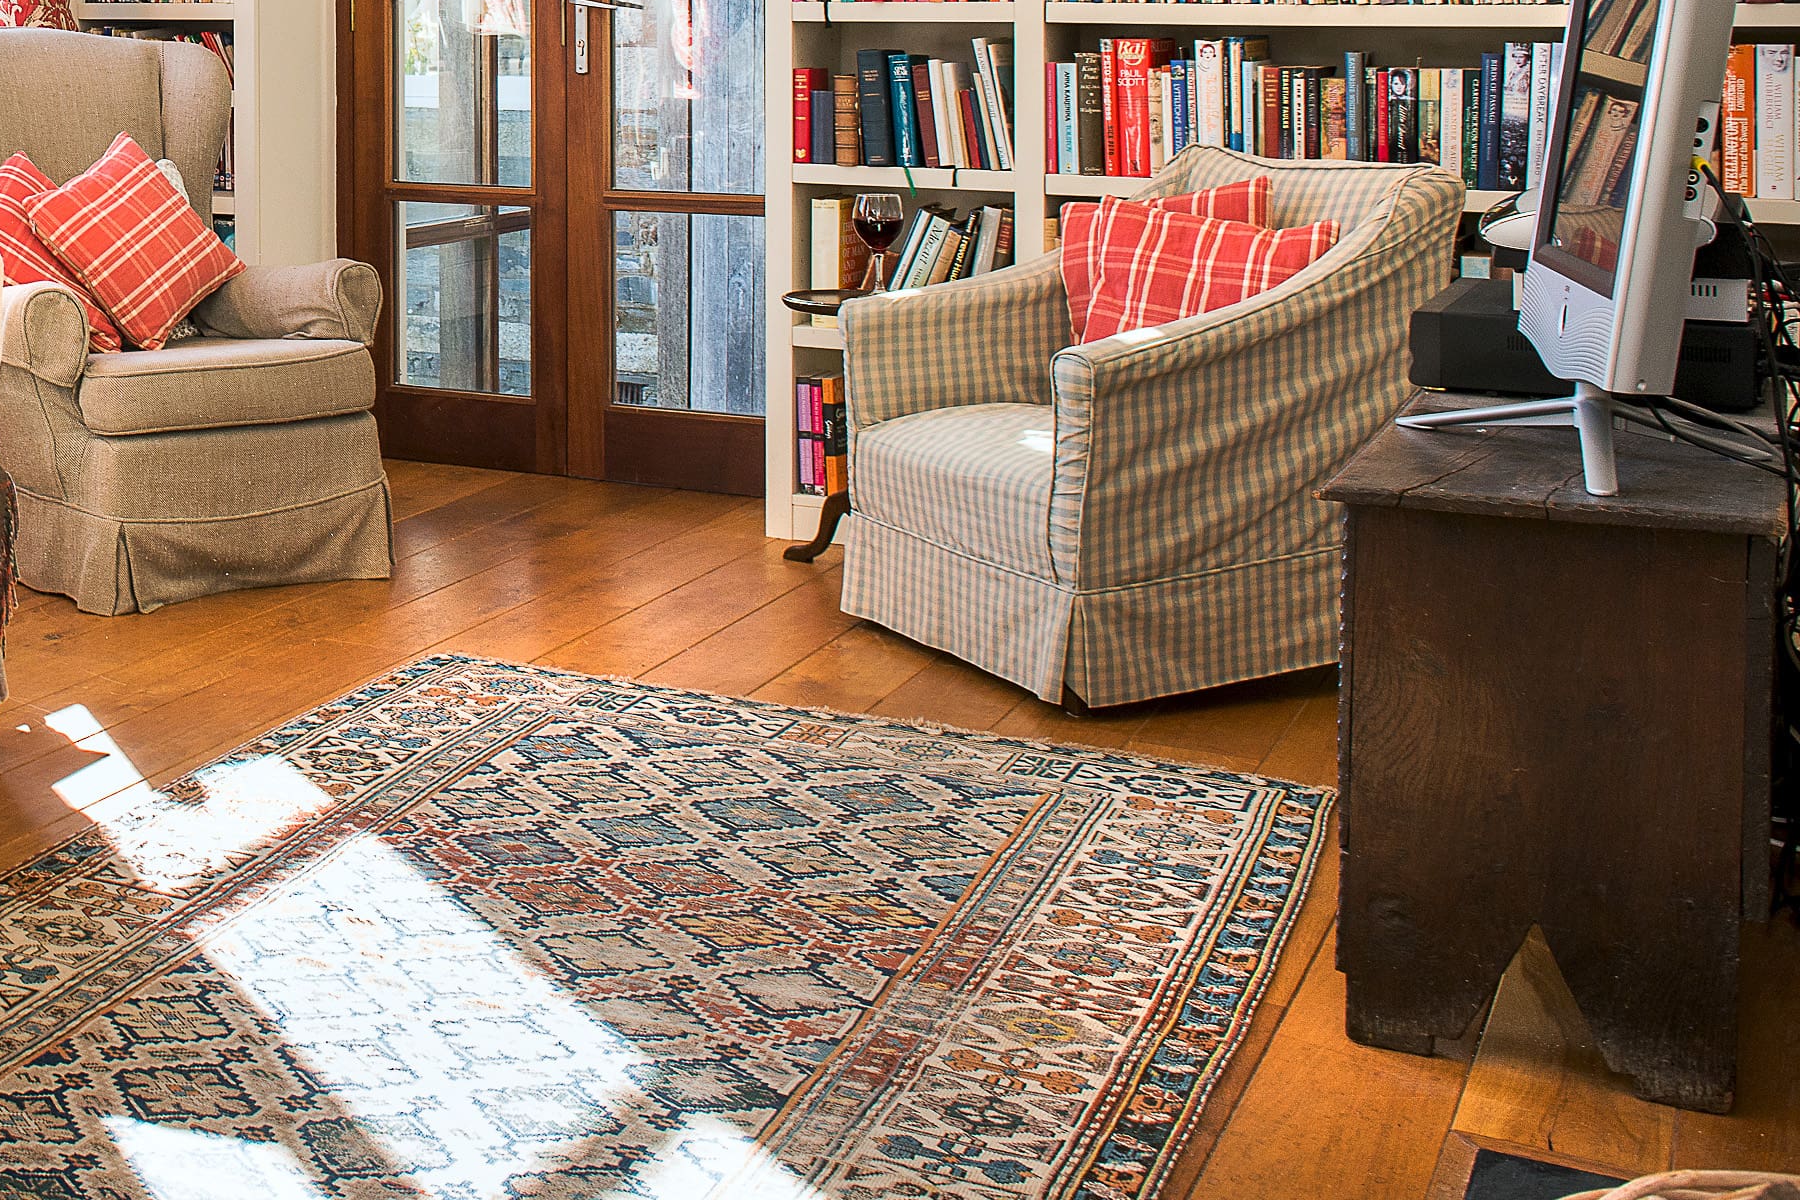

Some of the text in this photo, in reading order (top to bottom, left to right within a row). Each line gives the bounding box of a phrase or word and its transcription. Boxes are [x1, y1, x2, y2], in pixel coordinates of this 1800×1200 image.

[1119, 69, 1143, 78] PAUL
[1488, 59, 1498, 80] BIRDS
[1537, 47, 1547, 75] AFTER
[1117, 78, 1147, 87] SCOTT
[1282, 70, 1290, 129] SEBASTIAN FAULKS
[1737, 78, 1745, 112] LONGFORD
[1063, 90, 1071, 122] KARENINA
[1450, 92, 1458, 141] ALEXANDER
[1488, 94, 1497, 124] PASSAGE
[1536, 77, 1546, 124] DAYBREAK
[1765, 73, 1774, 129] WILBERFORCE
[1775, 83, 1783, 120] WILLIAM
[1470, 78, 1479, 171] CLARISSA DICKSON WRIGHT
[1738, 117, 1747, 141] Sword
[1725, 116, 1738, 193] WELLINGTON
[1738, 162, 1747, 180] Years
[1776, 134, 1785, 181] WILLIAM
